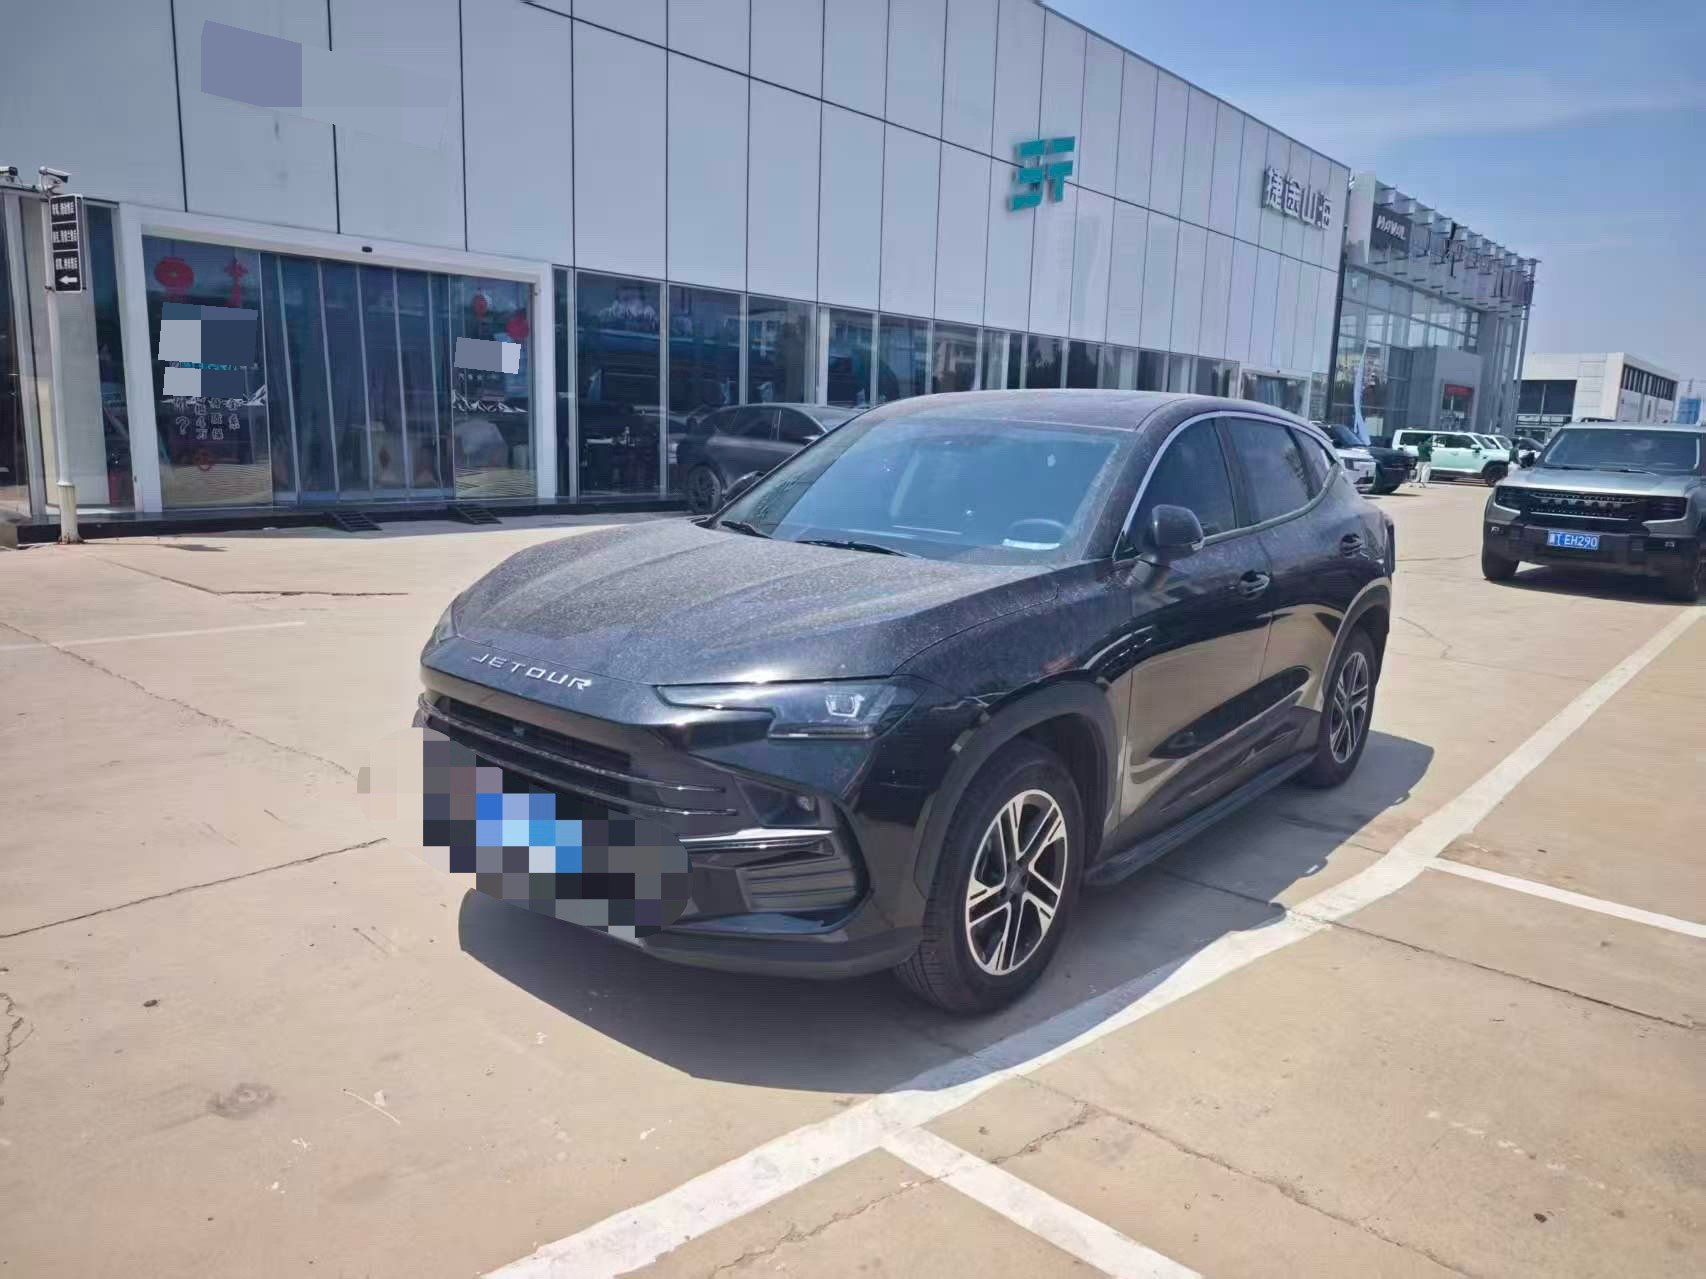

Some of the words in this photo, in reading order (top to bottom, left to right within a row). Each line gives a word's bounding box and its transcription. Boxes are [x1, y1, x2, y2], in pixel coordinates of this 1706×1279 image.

[1265, 167, 1332, 231] 捷途山海
[1376, 214, 1407, 241] HAVAL
[471, 653, 592, 690] JETOUR
